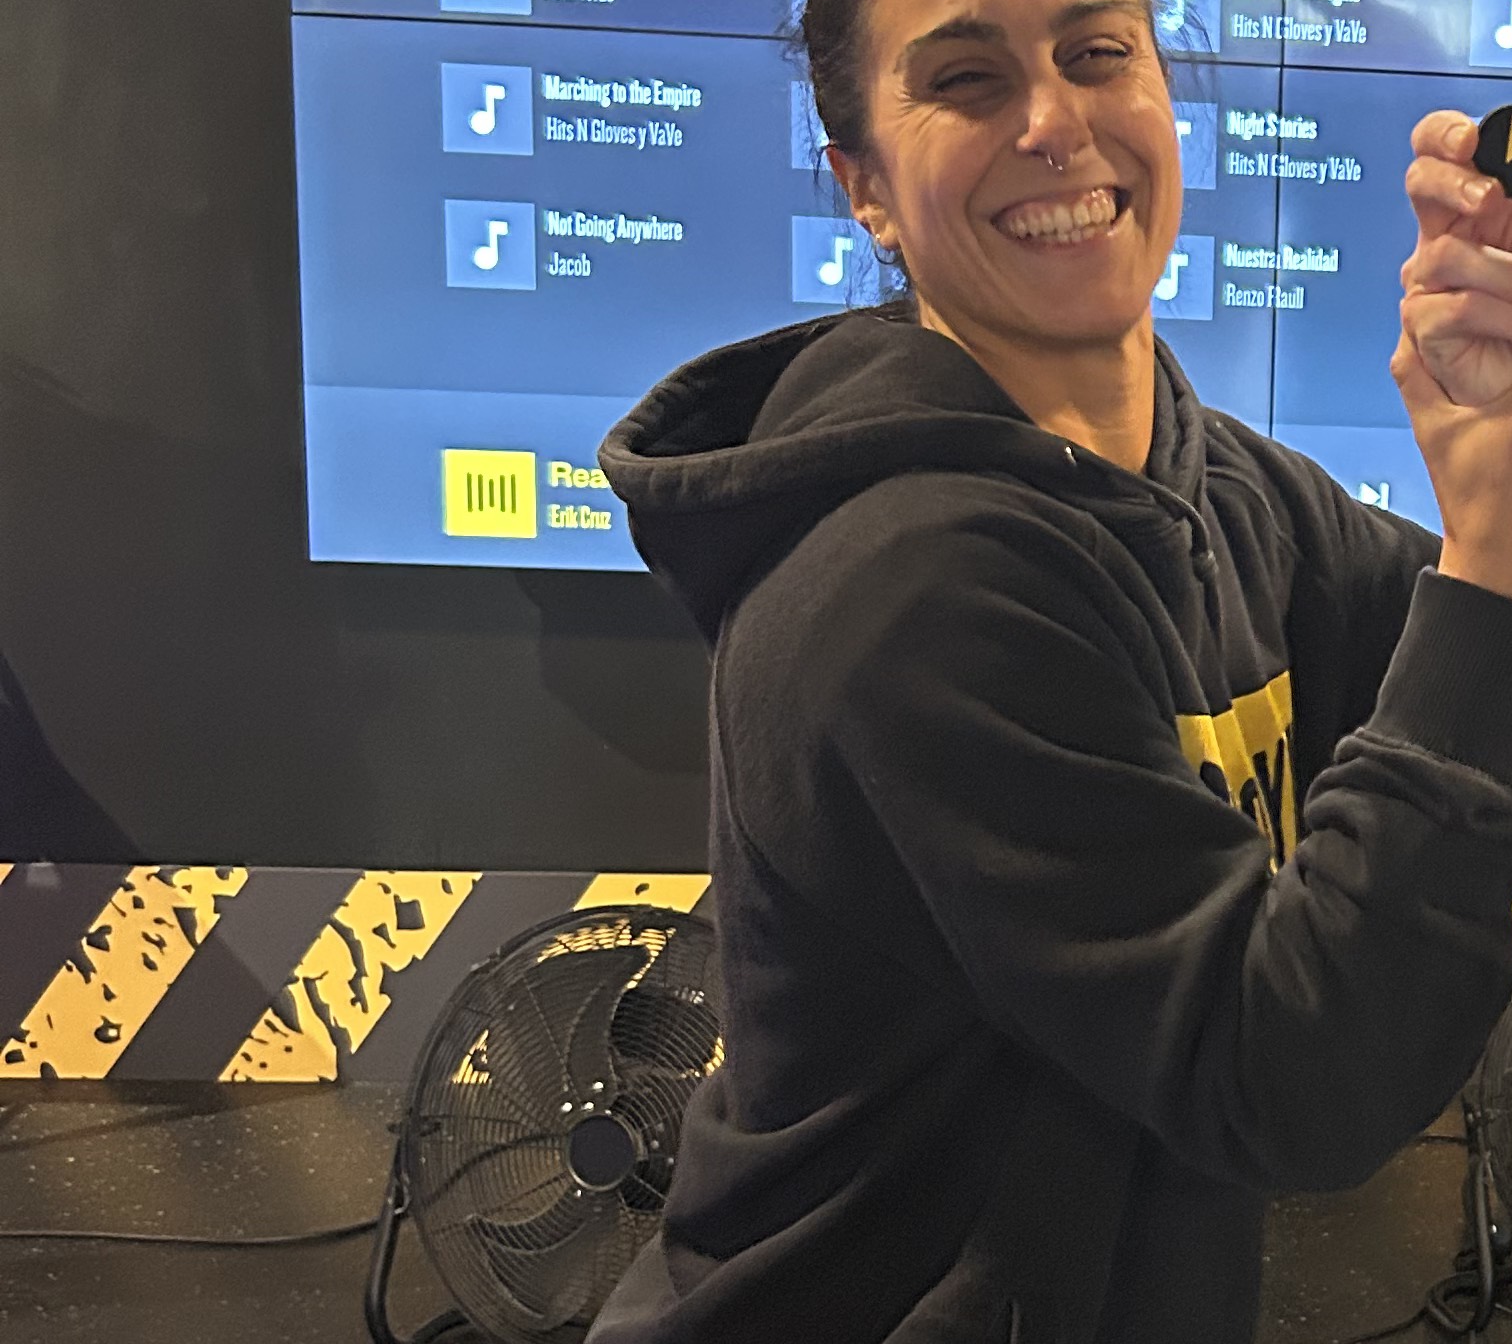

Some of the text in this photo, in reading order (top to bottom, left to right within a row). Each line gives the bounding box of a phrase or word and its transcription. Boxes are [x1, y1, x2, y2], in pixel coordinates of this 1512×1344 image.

[1232, 13, 1368, 47] Hits N Gloves y VaVe
[543, 74, 702, 111] Marching to the Empire
[545, 116, 683, 150] Hits N Gloves y VaVe
[1228, 111, 1318, 141] Night Stories
[1228, 151, 1362, 185] Hits N Gloves y VaVe
[546, 209, 683, 245] Not Going Anywhere
[548, 251, 592, 277] Jacob
[1224, 242, 1340, 272] Nuestra Realidad
[1225, 281, 1265, 307] Renzo
[549, 504, 613, 530] Erik Cruz
